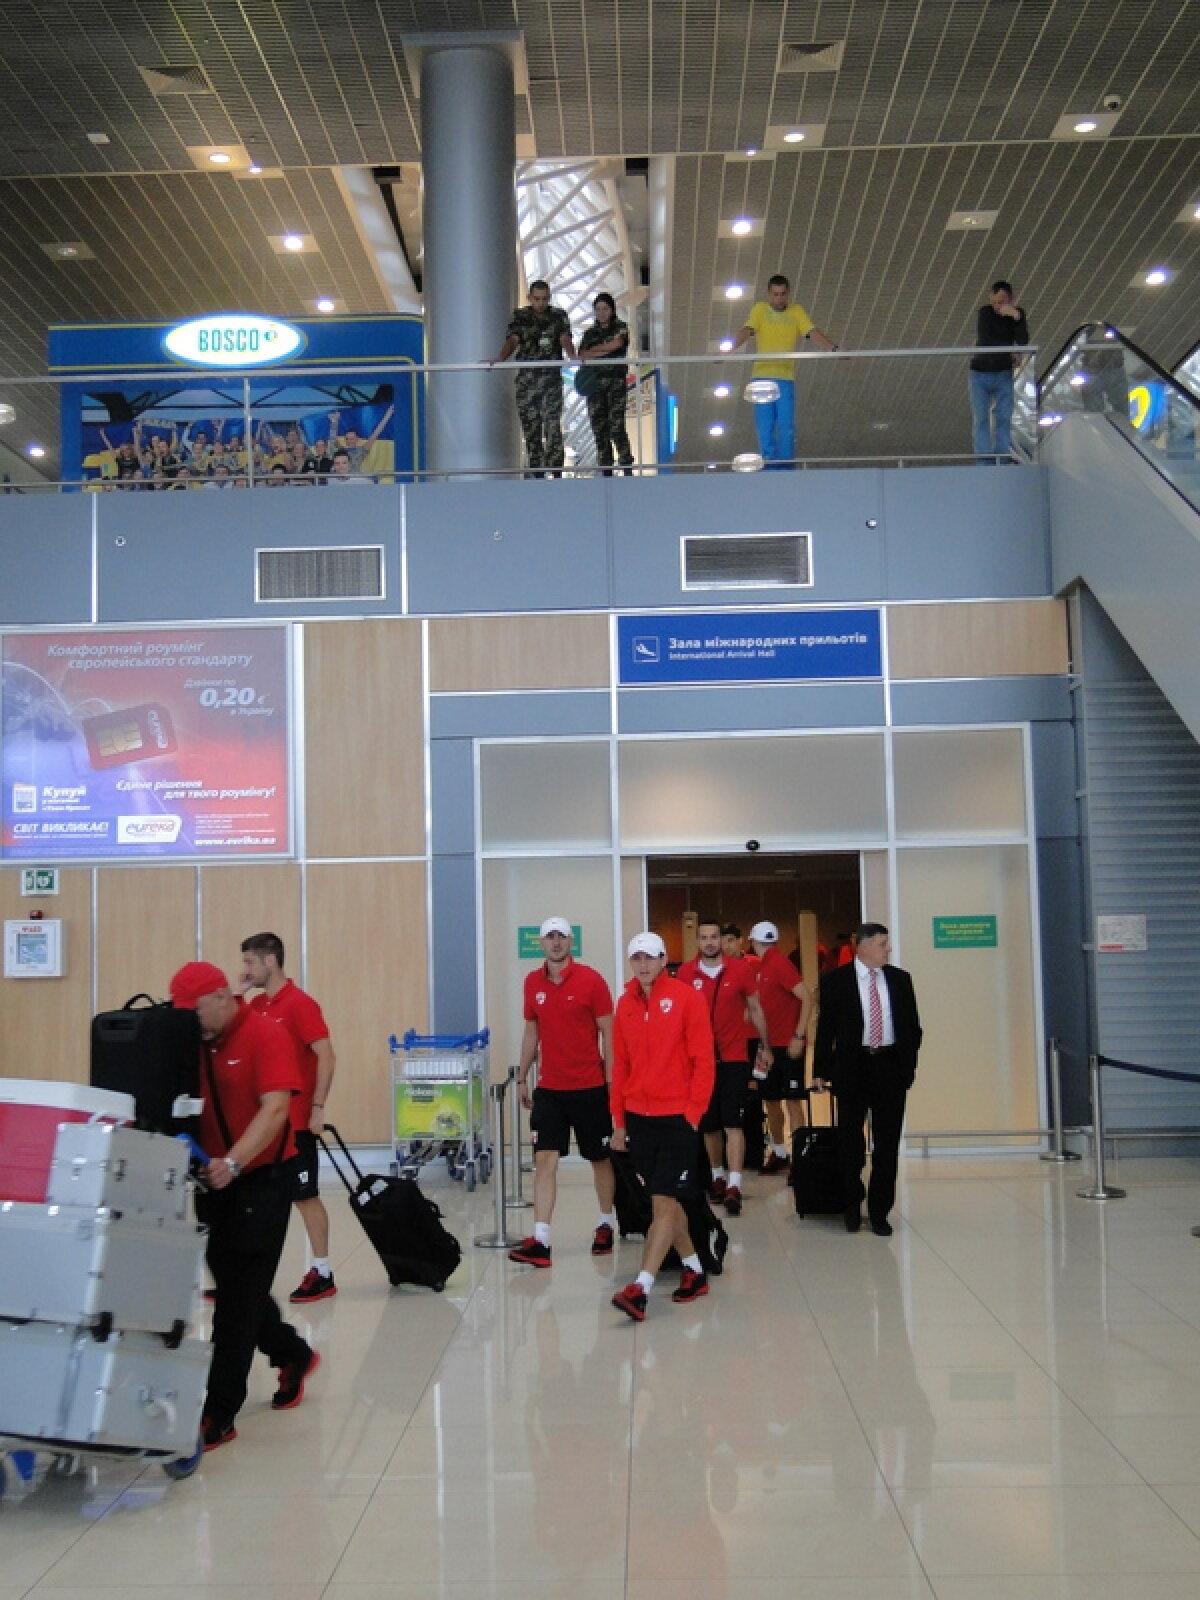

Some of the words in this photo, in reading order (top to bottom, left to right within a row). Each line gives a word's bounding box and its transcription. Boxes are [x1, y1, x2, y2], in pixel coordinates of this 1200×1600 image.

[198, 328, 260, 352] BOSCO
[47, 642, 143, 657] Комфортний
[145, 640, 204, 655] роумінг
[669, 637, 701, 649] Зала
[704, 635, 796, 649] міжнародних
[799, 631, 868, 648] прильотів
[68, 656, 176, 671] європейського
[178, 653, 253, 668] стандарту
[757, 649, 776, 657] Hall
[200, 687, 256, 708] 0,20
